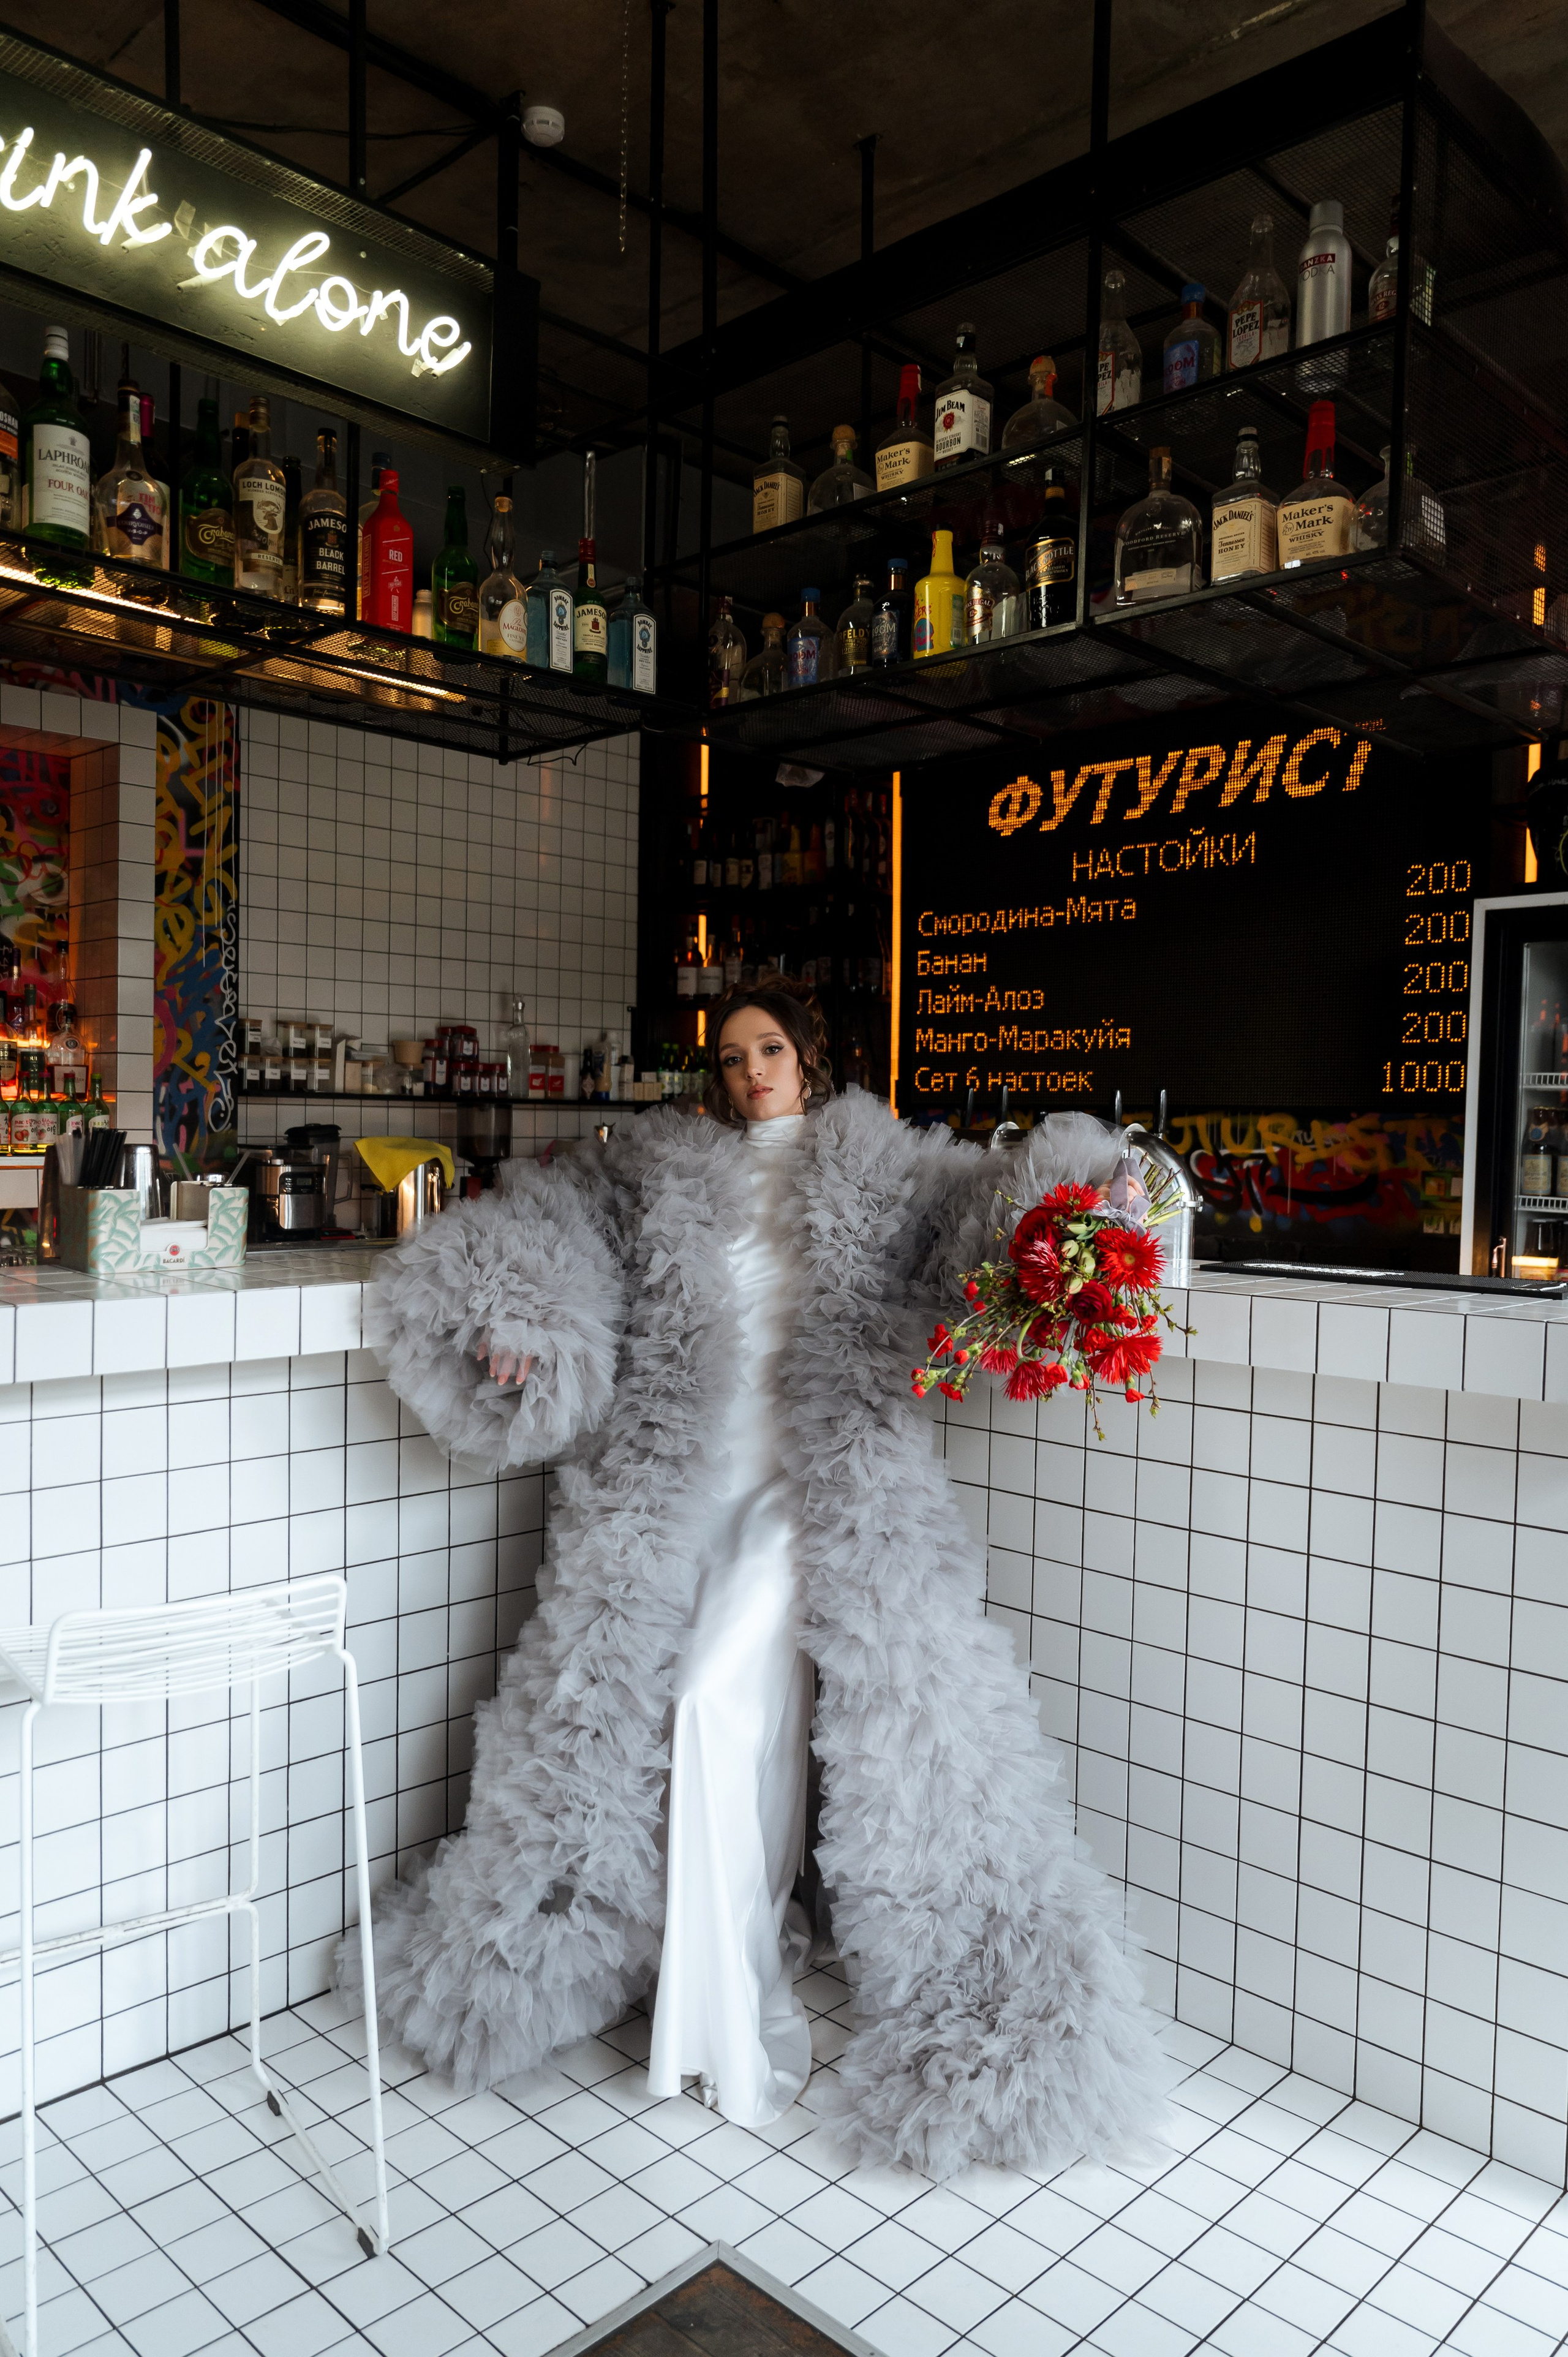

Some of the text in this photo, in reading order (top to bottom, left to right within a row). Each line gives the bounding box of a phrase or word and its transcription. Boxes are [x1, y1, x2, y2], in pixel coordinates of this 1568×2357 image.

[0, 127, 472, 371] ink alone
[1234, 312, 1257, 328] PEPE
[1232, 320, 1259, 338] LOPEZ
[935, 400, 965, 423] JIM BEAM
[936, 436, 961, 452] BOURBON
[876, 448, 910, 464] Maker's
[884, 458, 911, 470] Mark
[881, 470, 903, 480] WHISKY
[48, 478, 74, 493] FOUR
[757, 507, 775, 516] HONEY
[1282, 504, 1333, 522] Maker's
[308, 518, 347, 534] JAMESO
[1213, 510, 1254, 530] JACK DANIEL'S
[1295, 516, 1334, 531] Mark
[1156, 530, 1186, 540] RESERVE
[1218, 537, 1245, 548] Tennessee
[1289, 531, 1325, 543] WHISKY
[319, 547, 344, 561] BLACK
[389, 549, 403, 563] RED
[1218, 543, 1245, 554] HONEY
[257, 554, 282, 564] RESERVE
[1025, 546, 1074, 581] BLACK BOTTLE
[316, 560, 345, 576] BARREL
[554, 595, 568, 606] BOMBAY
[553, 620, 569, 632] SAPPHIRE
[638, 620, 653, 630] BOMBAY
[636, 643, 654, 654] SAPPHIRE
[1073, 827, 1255, 881] НАСТОЙКИ
[1406, 860, 1471, 896] 200
[919, 896, 1136, 936] Смородина-Мята
[1405, 911, 1469, 945] 200
[918, 950, 987, 975] Банан
[1403, 960, 1468, 994] 200
[917, 984, 1044, 1014] Лайм-Алоэ
[1402, 1011, 1466, 1043] 200
[916, 1019, 1131, 1054] Манго-Маракуйя
[915, 1066, 1093, 1092] Сет 6 настоек
[1382, 1061, 1464, 1093] 1000
